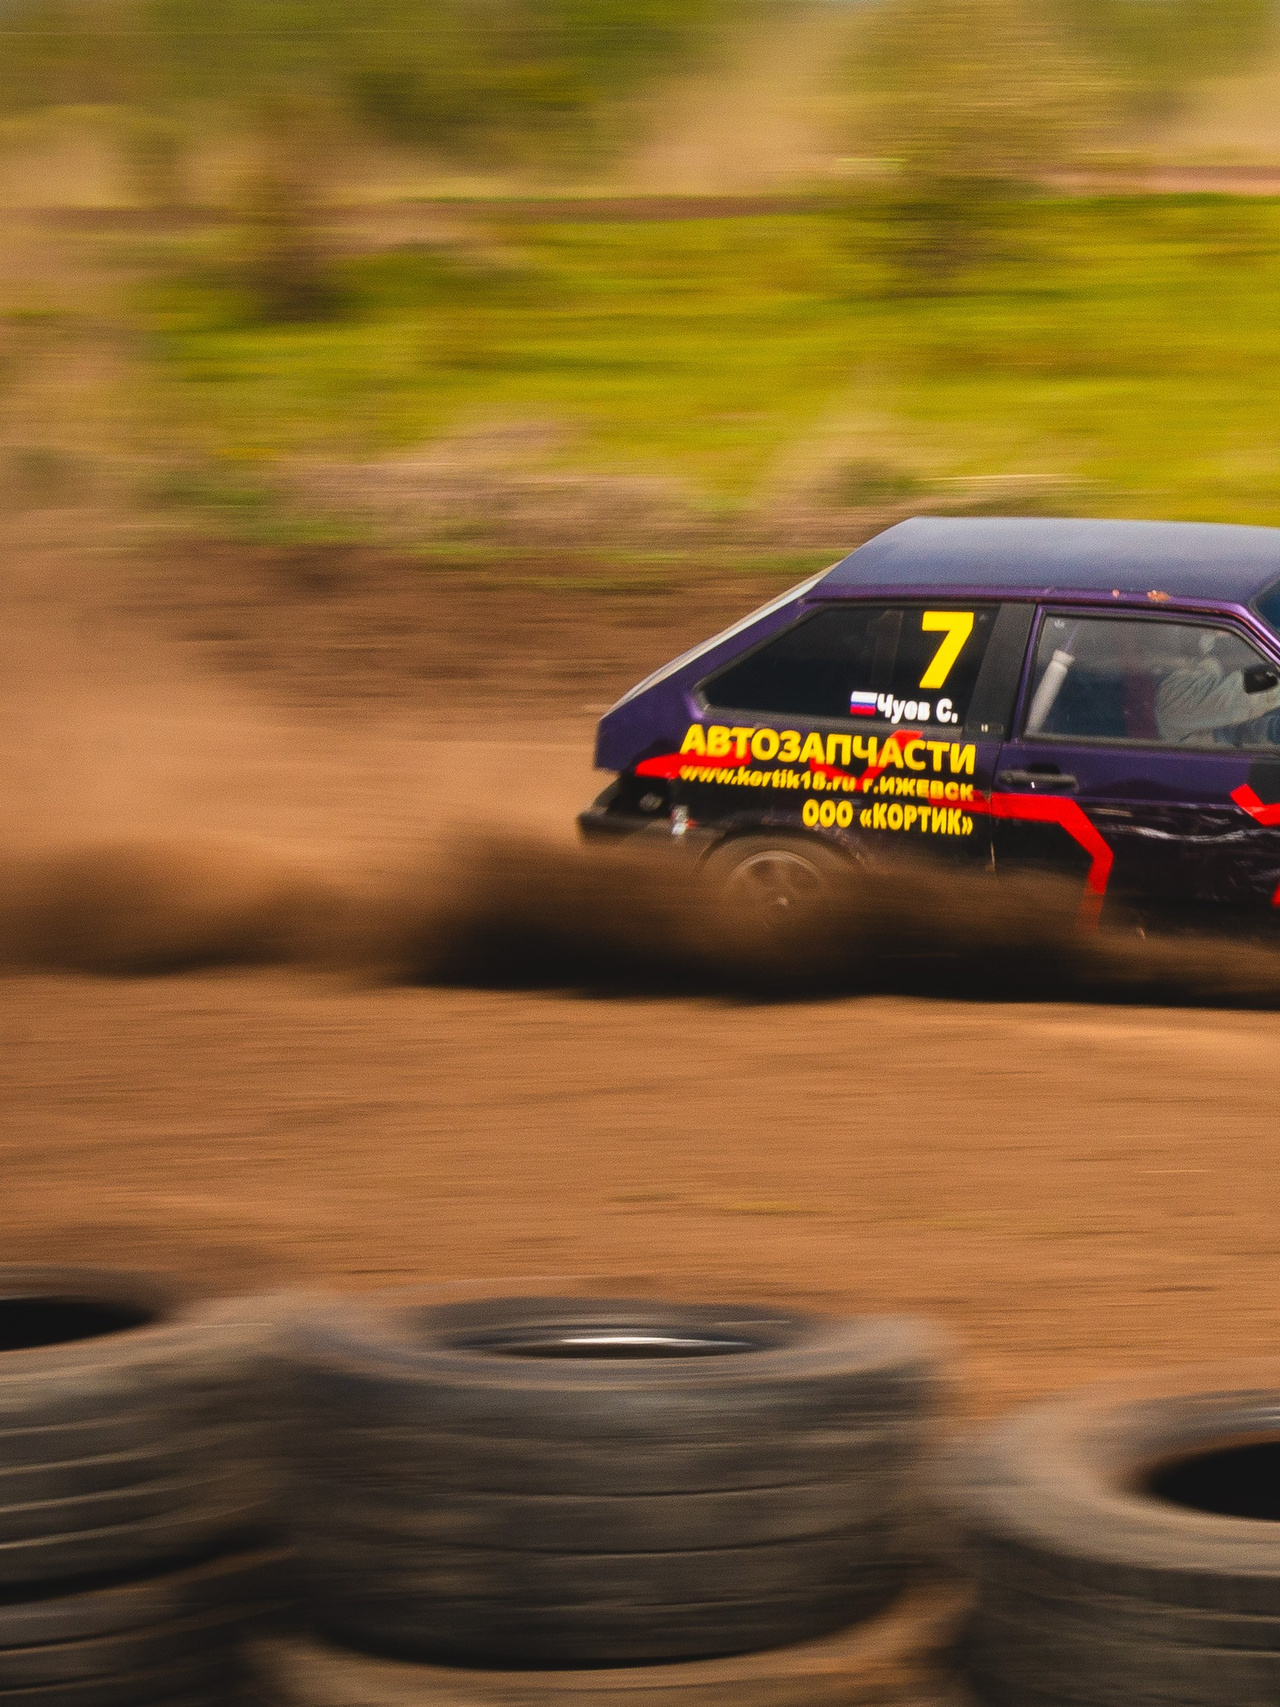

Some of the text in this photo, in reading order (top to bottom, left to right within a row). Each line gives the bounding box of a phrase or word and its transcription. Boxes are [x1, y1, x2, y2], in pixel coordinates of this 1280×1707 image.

[919, 611, 975, 689] 7
[877, 693, 959, 724] Чуев С.
[679, 723, 977, 775] АВТОЗАПЧАСТИ
[679, 765, 856, 793] www.kortik18.ru
[801, 798, 974, 836] ООО «КОРТИК»
